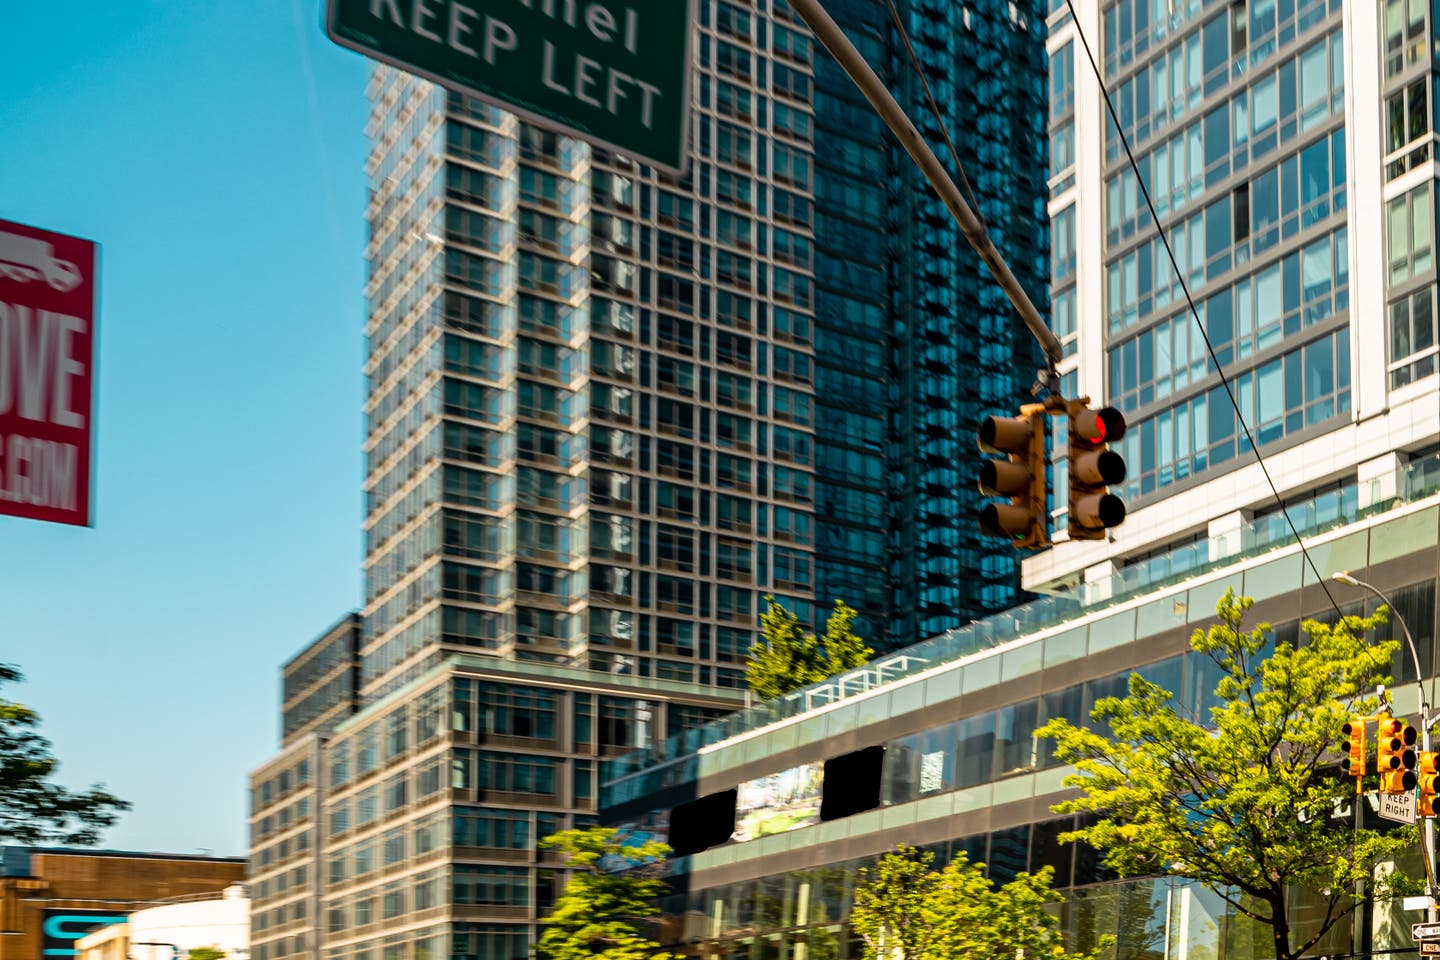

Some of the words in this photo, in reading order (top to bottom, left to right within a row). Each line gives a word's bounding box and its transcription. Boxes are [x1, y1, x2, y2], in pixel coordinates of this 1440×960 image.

[542, 39, 663, 130] LEFT
[1385, 803, 1410, 817] RIGHT
[1416, 927, 1427, 936] ONE
[1425, 944, 1437, 952] ONE
